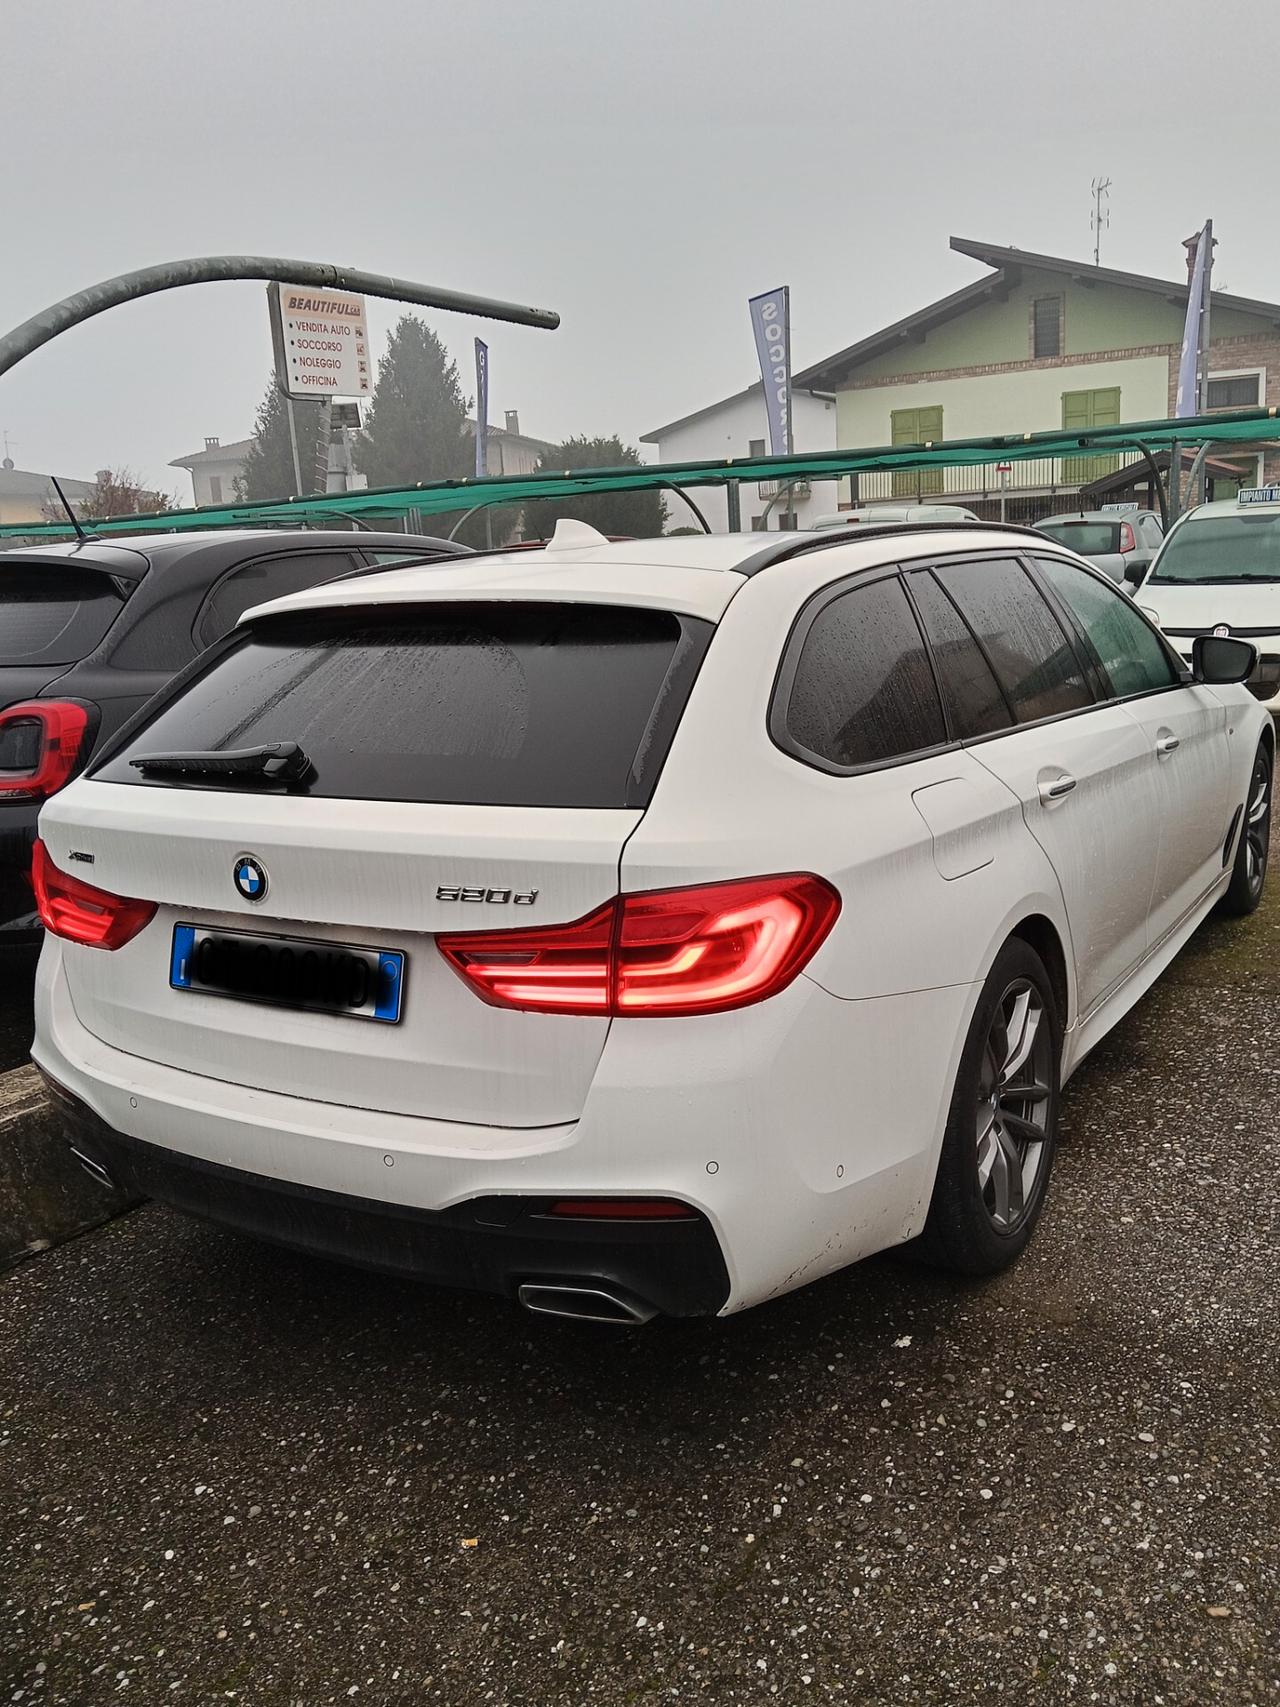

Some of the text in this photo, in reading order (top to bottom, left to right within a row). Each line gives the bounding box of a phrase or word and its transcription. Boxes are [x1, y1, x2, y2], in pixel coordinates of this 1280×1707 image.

[288, 297, 350, 316] BEAUTIFUL
[296, 321, 351, 335] VENDITA AUTO
[297, 339, 343, 352] SOCCORSO
[299, 357, 342, 369] NOLEGGIO
[301, 375, 338, 386] OFFICINA
[1240, 490, 1271, 502] IMPIANTO
